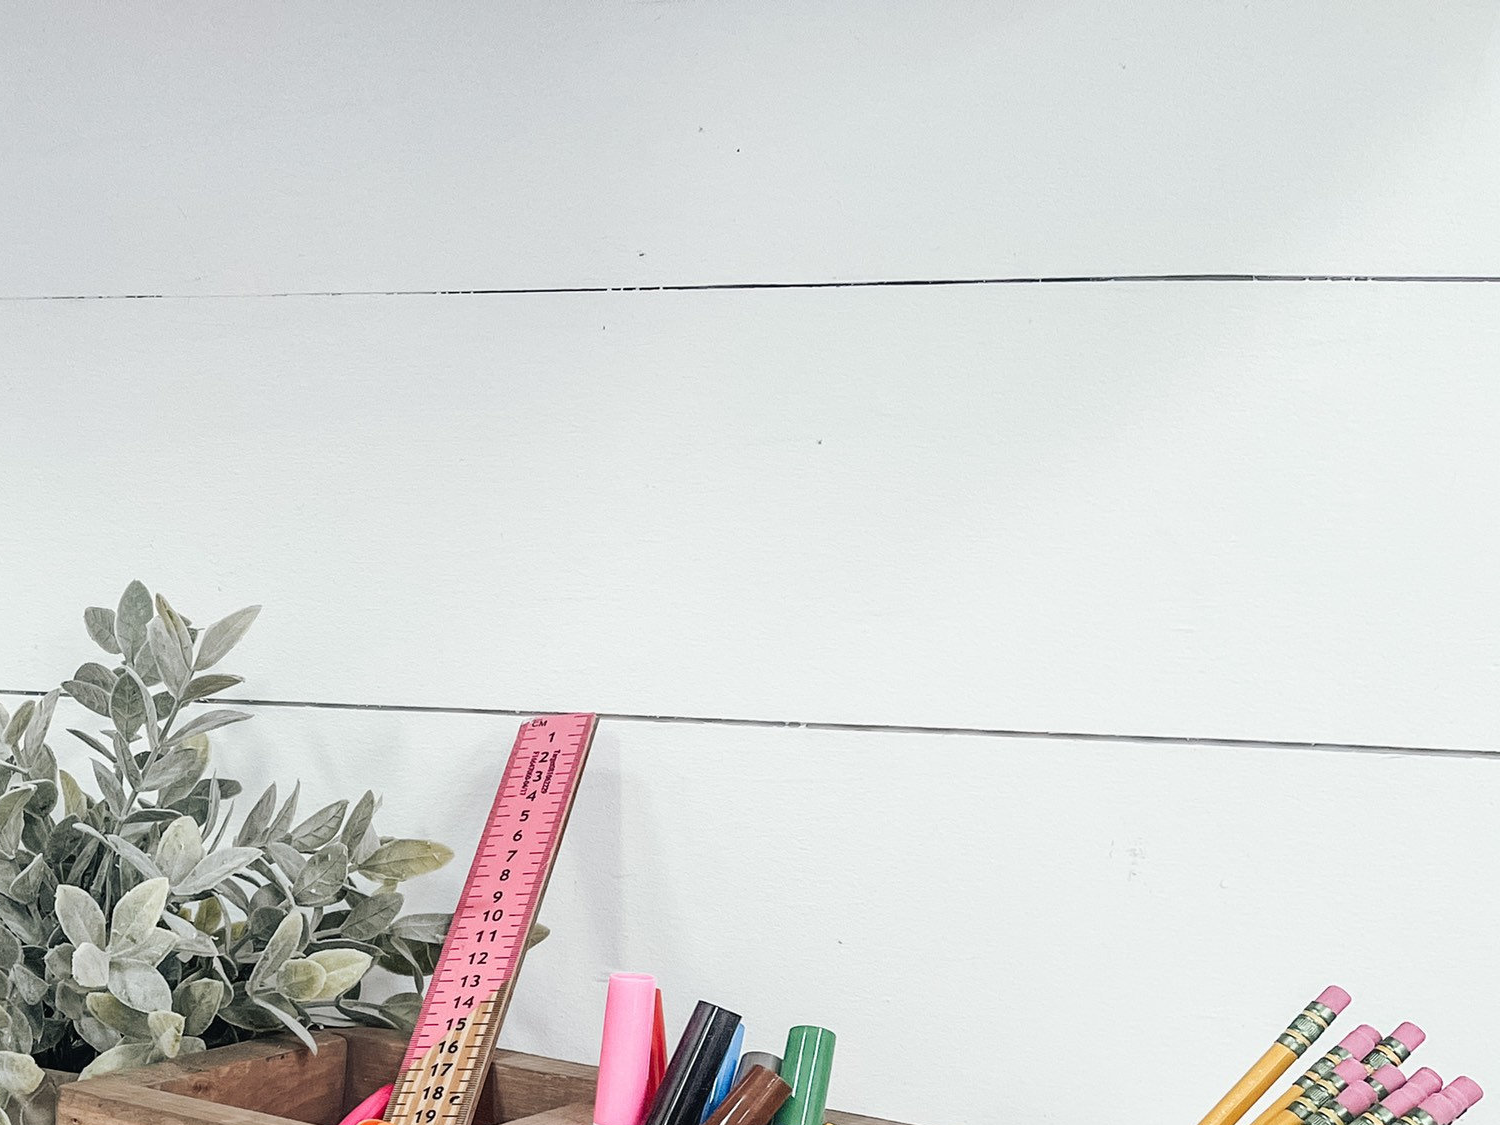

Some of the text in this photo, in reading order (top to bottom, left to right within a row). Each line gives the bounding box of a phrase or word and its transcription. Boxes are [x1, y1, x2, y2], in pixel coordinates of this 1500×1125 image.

[531, 719, 548, 728] CM
[548, 731, 556, 743] 1
[538, 751, 550, 763] 2
[532, 771, 543, 782] 3
[525, 790, 538, 802] 4
[519, 810, 531, 822] 5
[512, 829, 523, 842] 6
[506, 850, 518, 862] 7
[499, 869, 511, 882] 8
[493, 891, 503, 903] 9
[482, 909, 504, 922] 10
[475, 930, 498, 943] 11
[468, 952, 490, 965] 12
[460, 974, 481, 988] 13
[453, 996, 475, 1009] 14
[445, 1017, 467, 1031] 15
[438, 1040, 459, 1054] 16
[430, 1063, 454, 1077] 17
[422, 1086, 445, 1100] 18
[415, 1109, 437, 1123] 19
